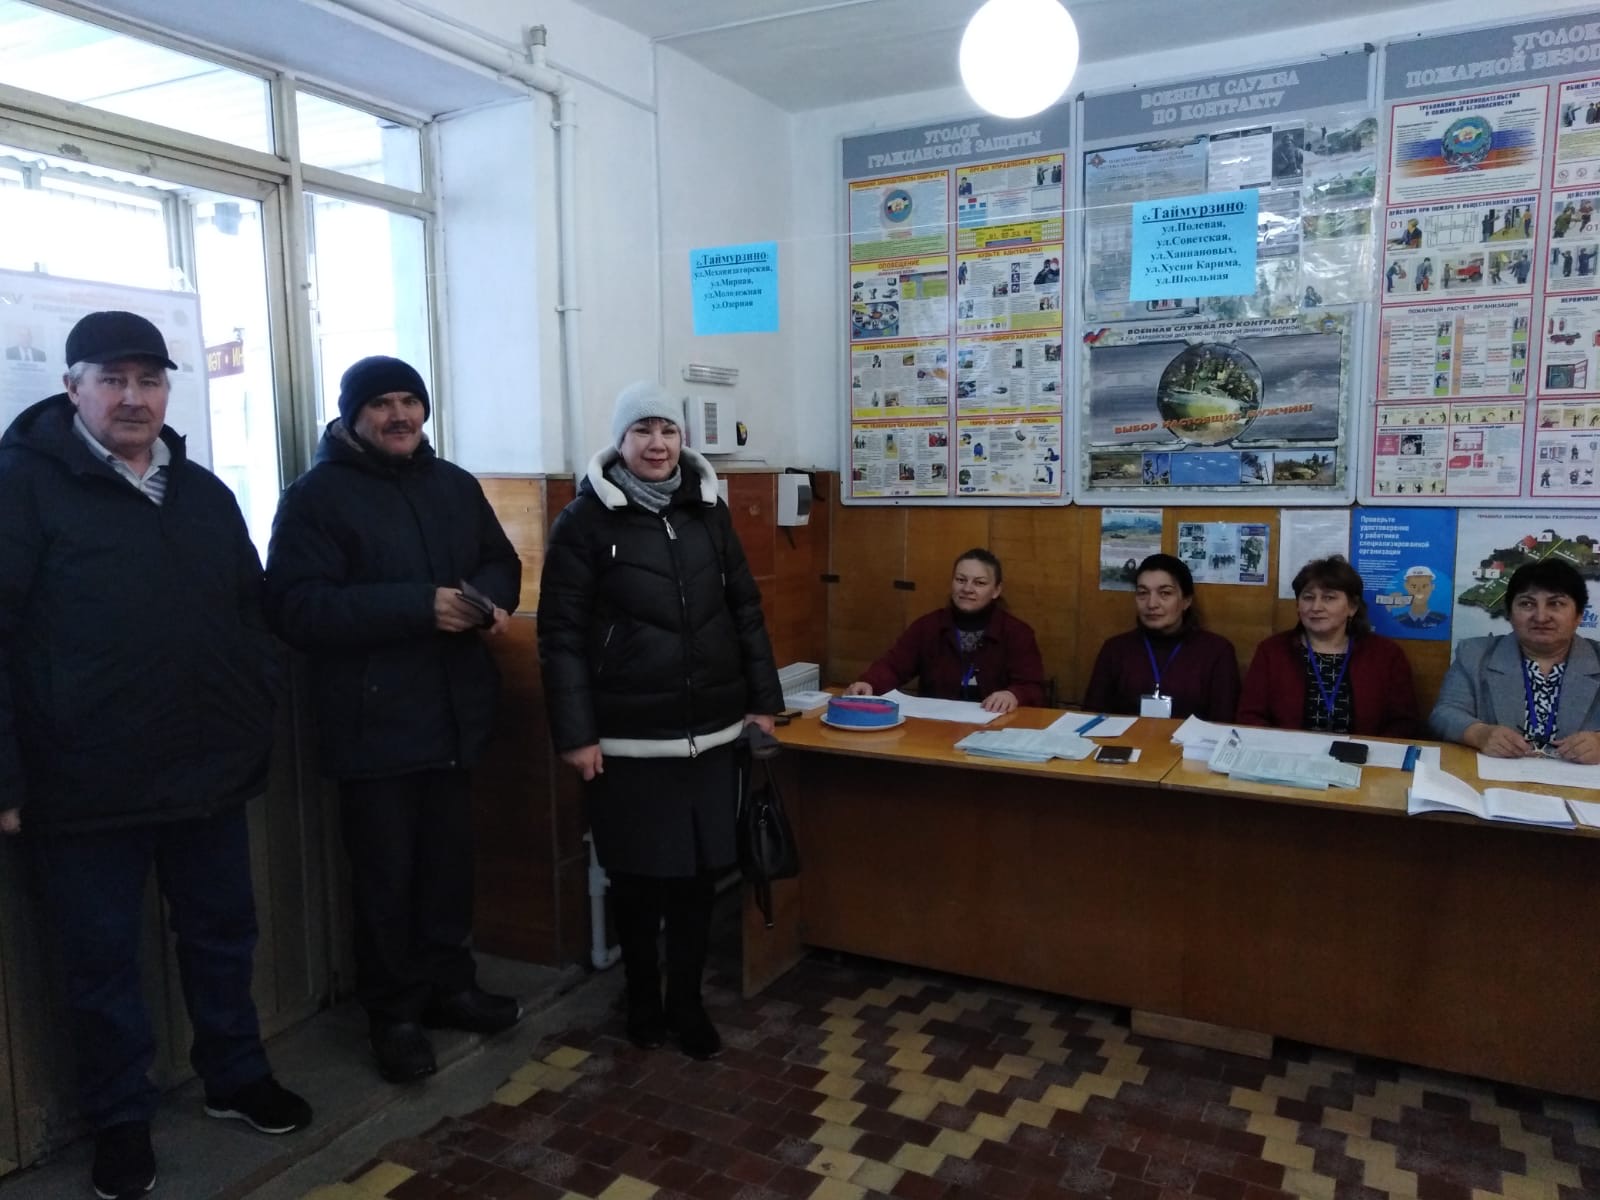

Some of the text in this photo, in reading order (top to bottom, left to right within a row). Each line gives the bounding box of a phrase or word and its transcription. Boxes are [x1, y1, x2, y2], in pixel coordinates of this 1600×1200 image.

[1512, 22, 1600, 51] УГОЛОК
[1406, 50, 1527, 88] ПОЖАРНОЙ
[1140, 70, 1299, 109] ВОЕННАЯ СЛУЖБА
[1152, 91, 1286, 125] ПО КОНТРАКТУ
[867, 130, 1042, 169] ГРАЖДАНСКОЙ ЗАЩИТЫ
[924, 123, 981, 145] УГОЛОК
[1127, 317, 1298, 335] ВОЕННАЯ СЛУЖБА ПО КОНТРАКТУ
[1115, 423, 1158, 434] ВЫБОР
